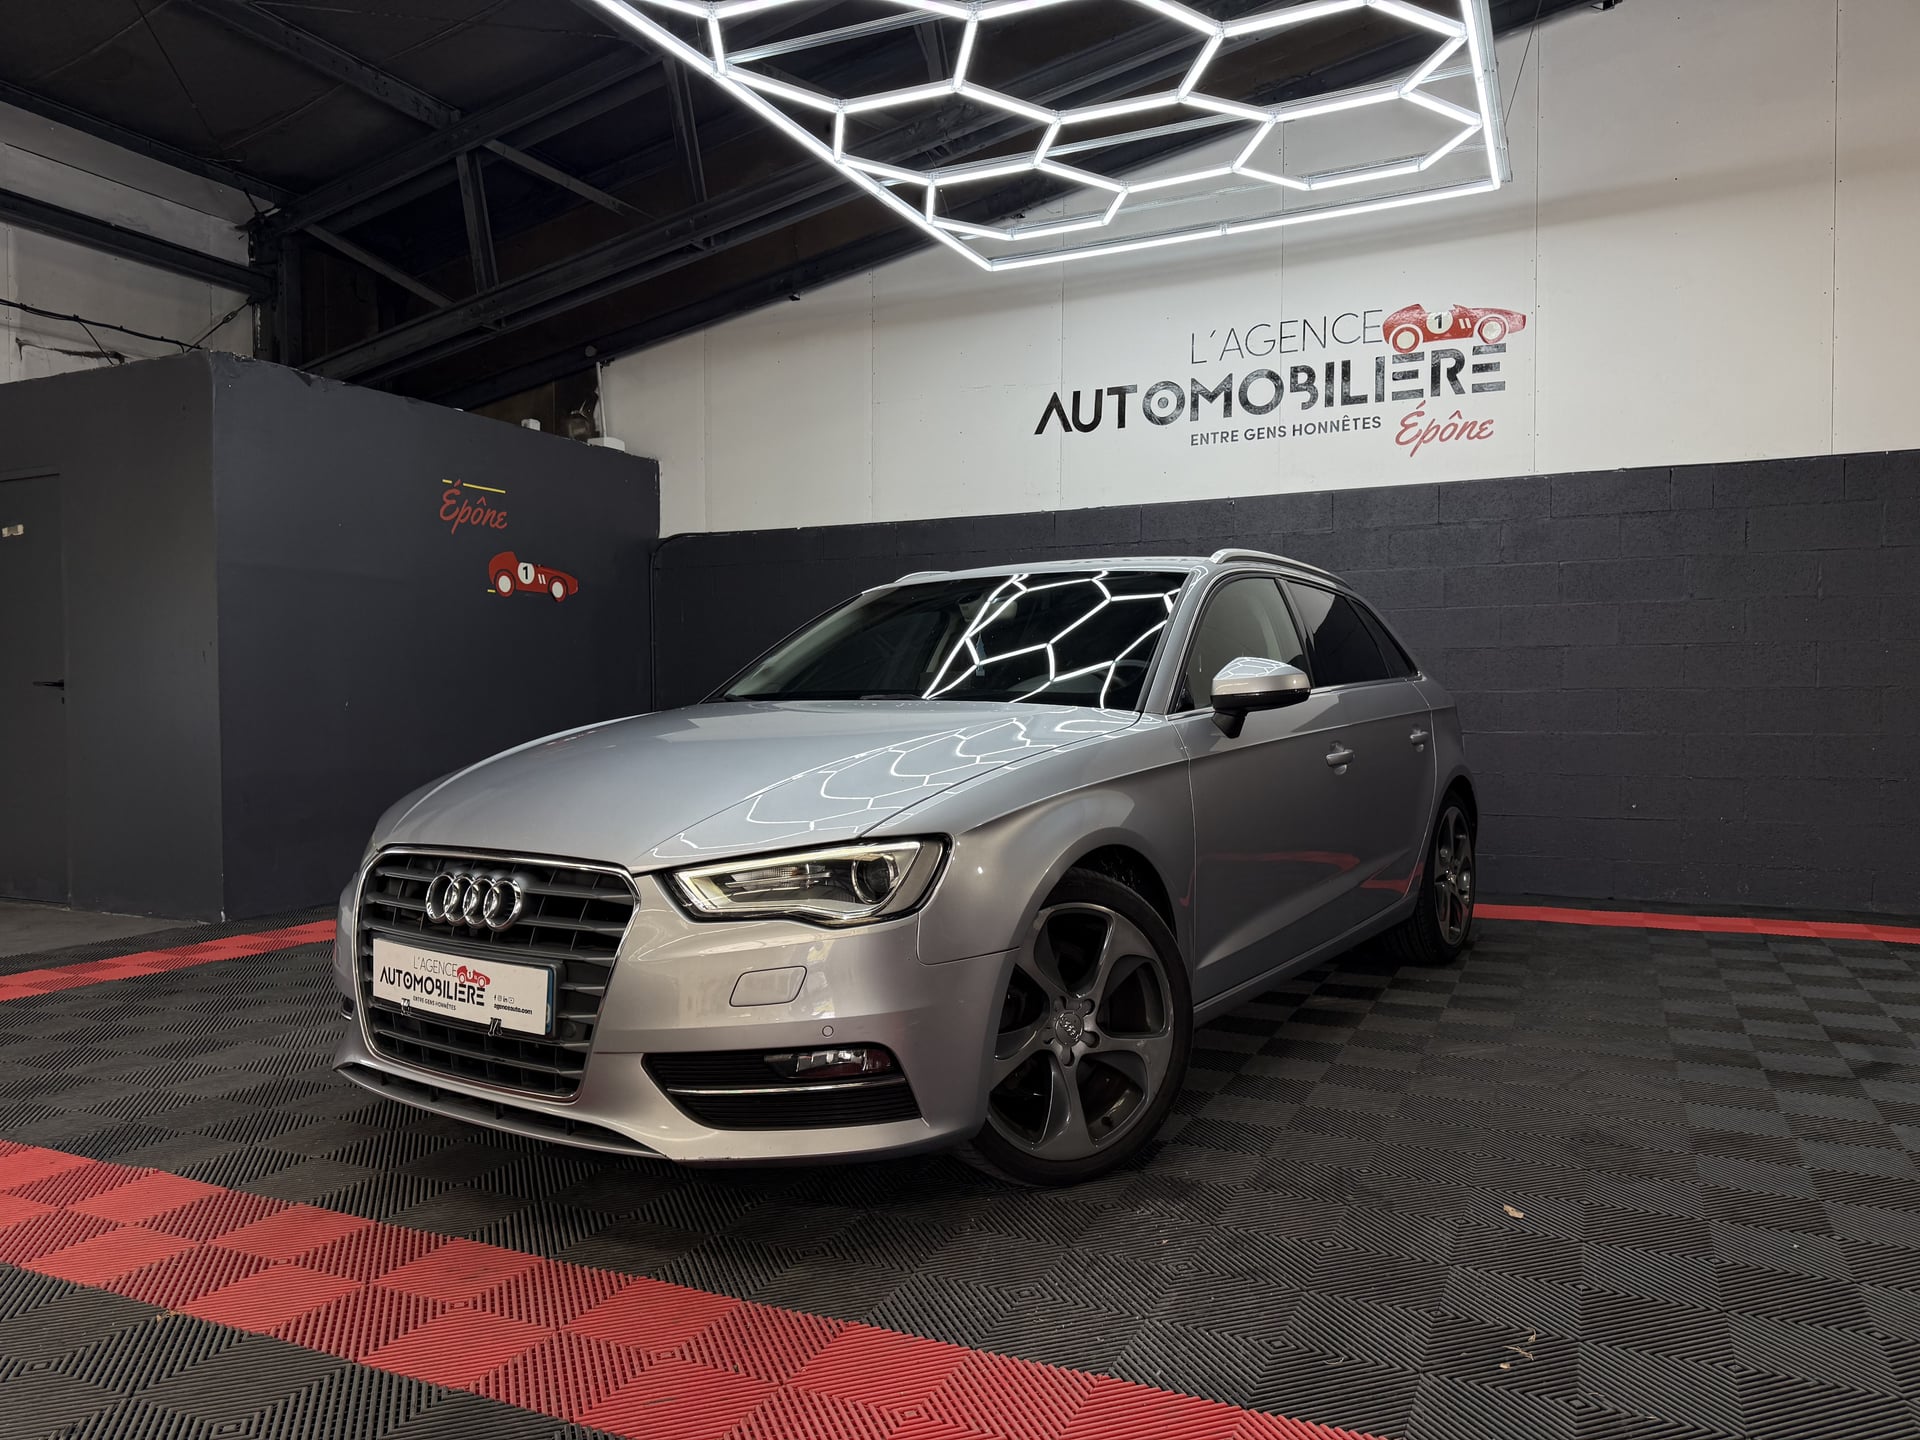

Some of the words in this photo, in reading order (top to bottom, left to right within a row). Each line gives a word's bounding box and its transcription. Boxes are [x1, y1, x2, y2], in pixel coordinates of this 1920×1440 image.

[1191, 310, 1383, 364] L'AGENCE
[1190, 429, 1240, 446] ENTRE
[1244, 424, 1287, 440] GENS
[1292, 415, 1382, 437] HONNÊTES
[1395, 400, 1494, 457] Épône
[439, 479, 508, 535] Épône
[522, 565, 529, 580] 1
[413, 955, 458, 977] L'AGENCE
